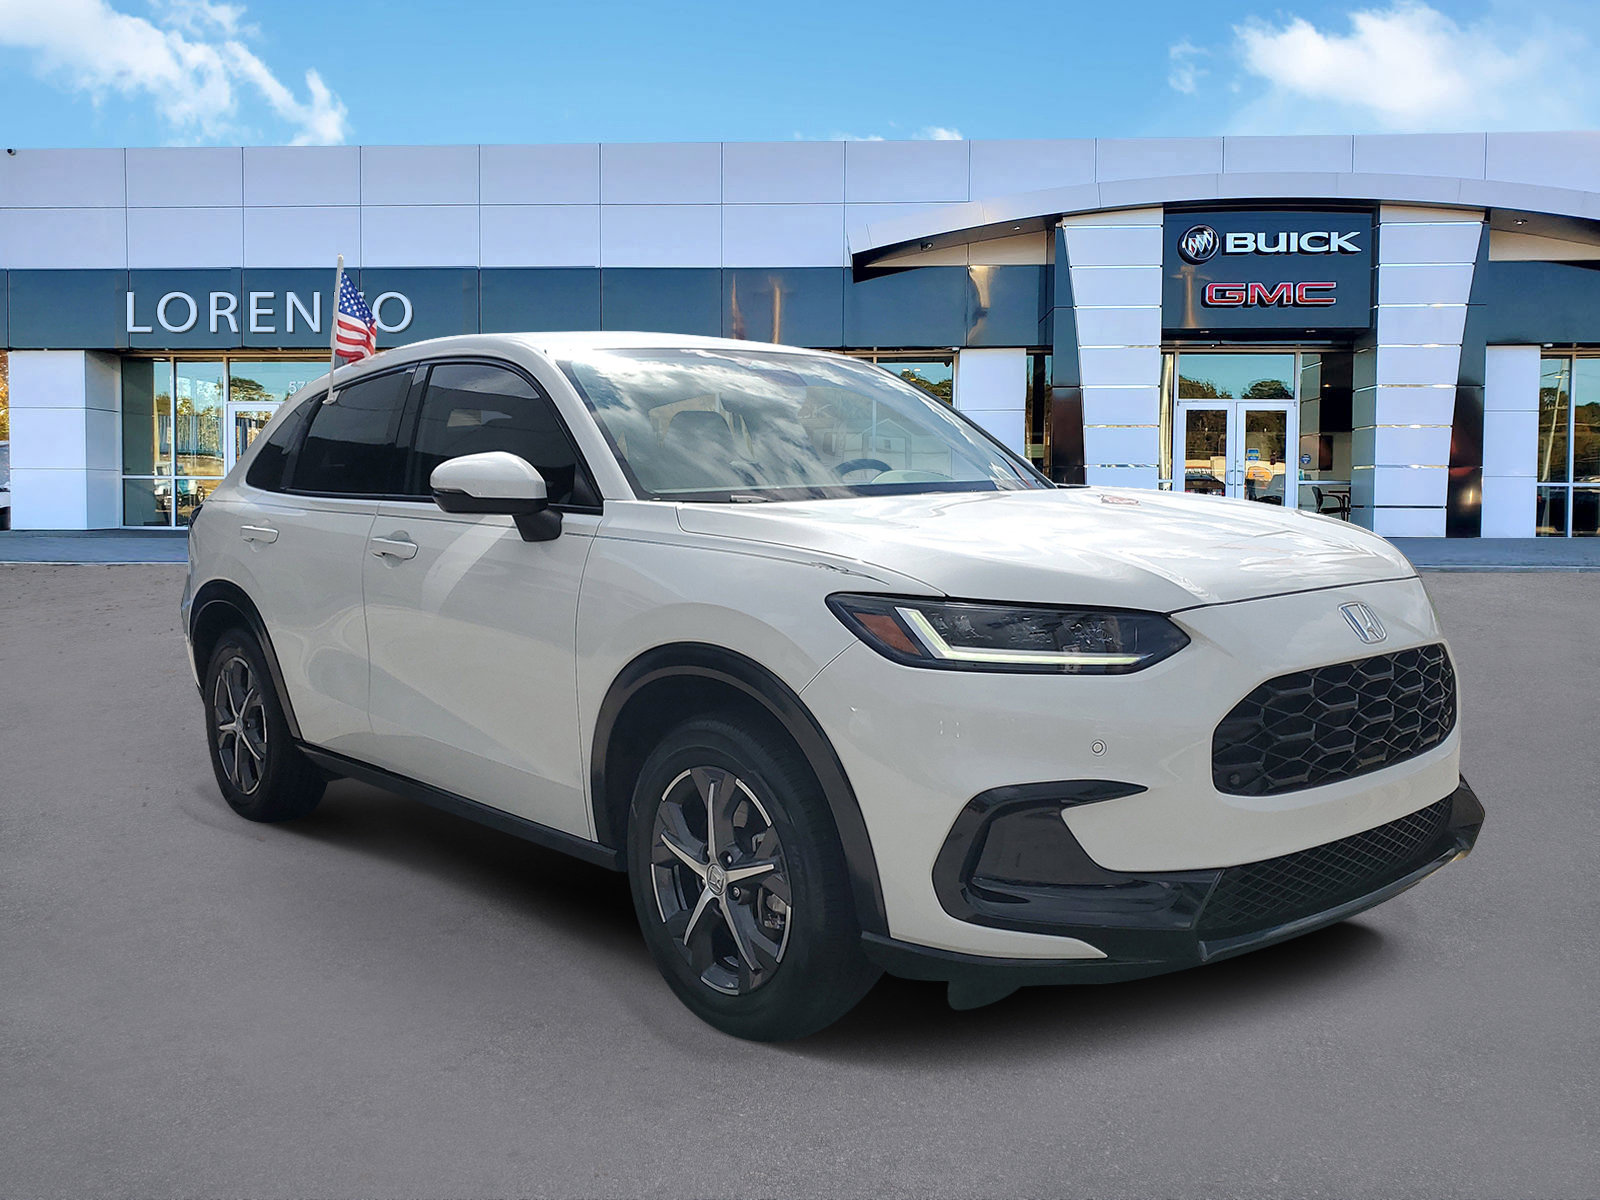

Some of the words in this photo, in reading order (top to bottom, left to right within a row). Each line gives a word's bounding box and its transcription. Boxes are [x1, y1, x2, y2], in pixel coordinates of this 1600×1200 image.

[1226, 231, 1362, 253] BUICK
[1206, 282, 1336, 305] GMC
[127, 291, 413, 333] LORENO
